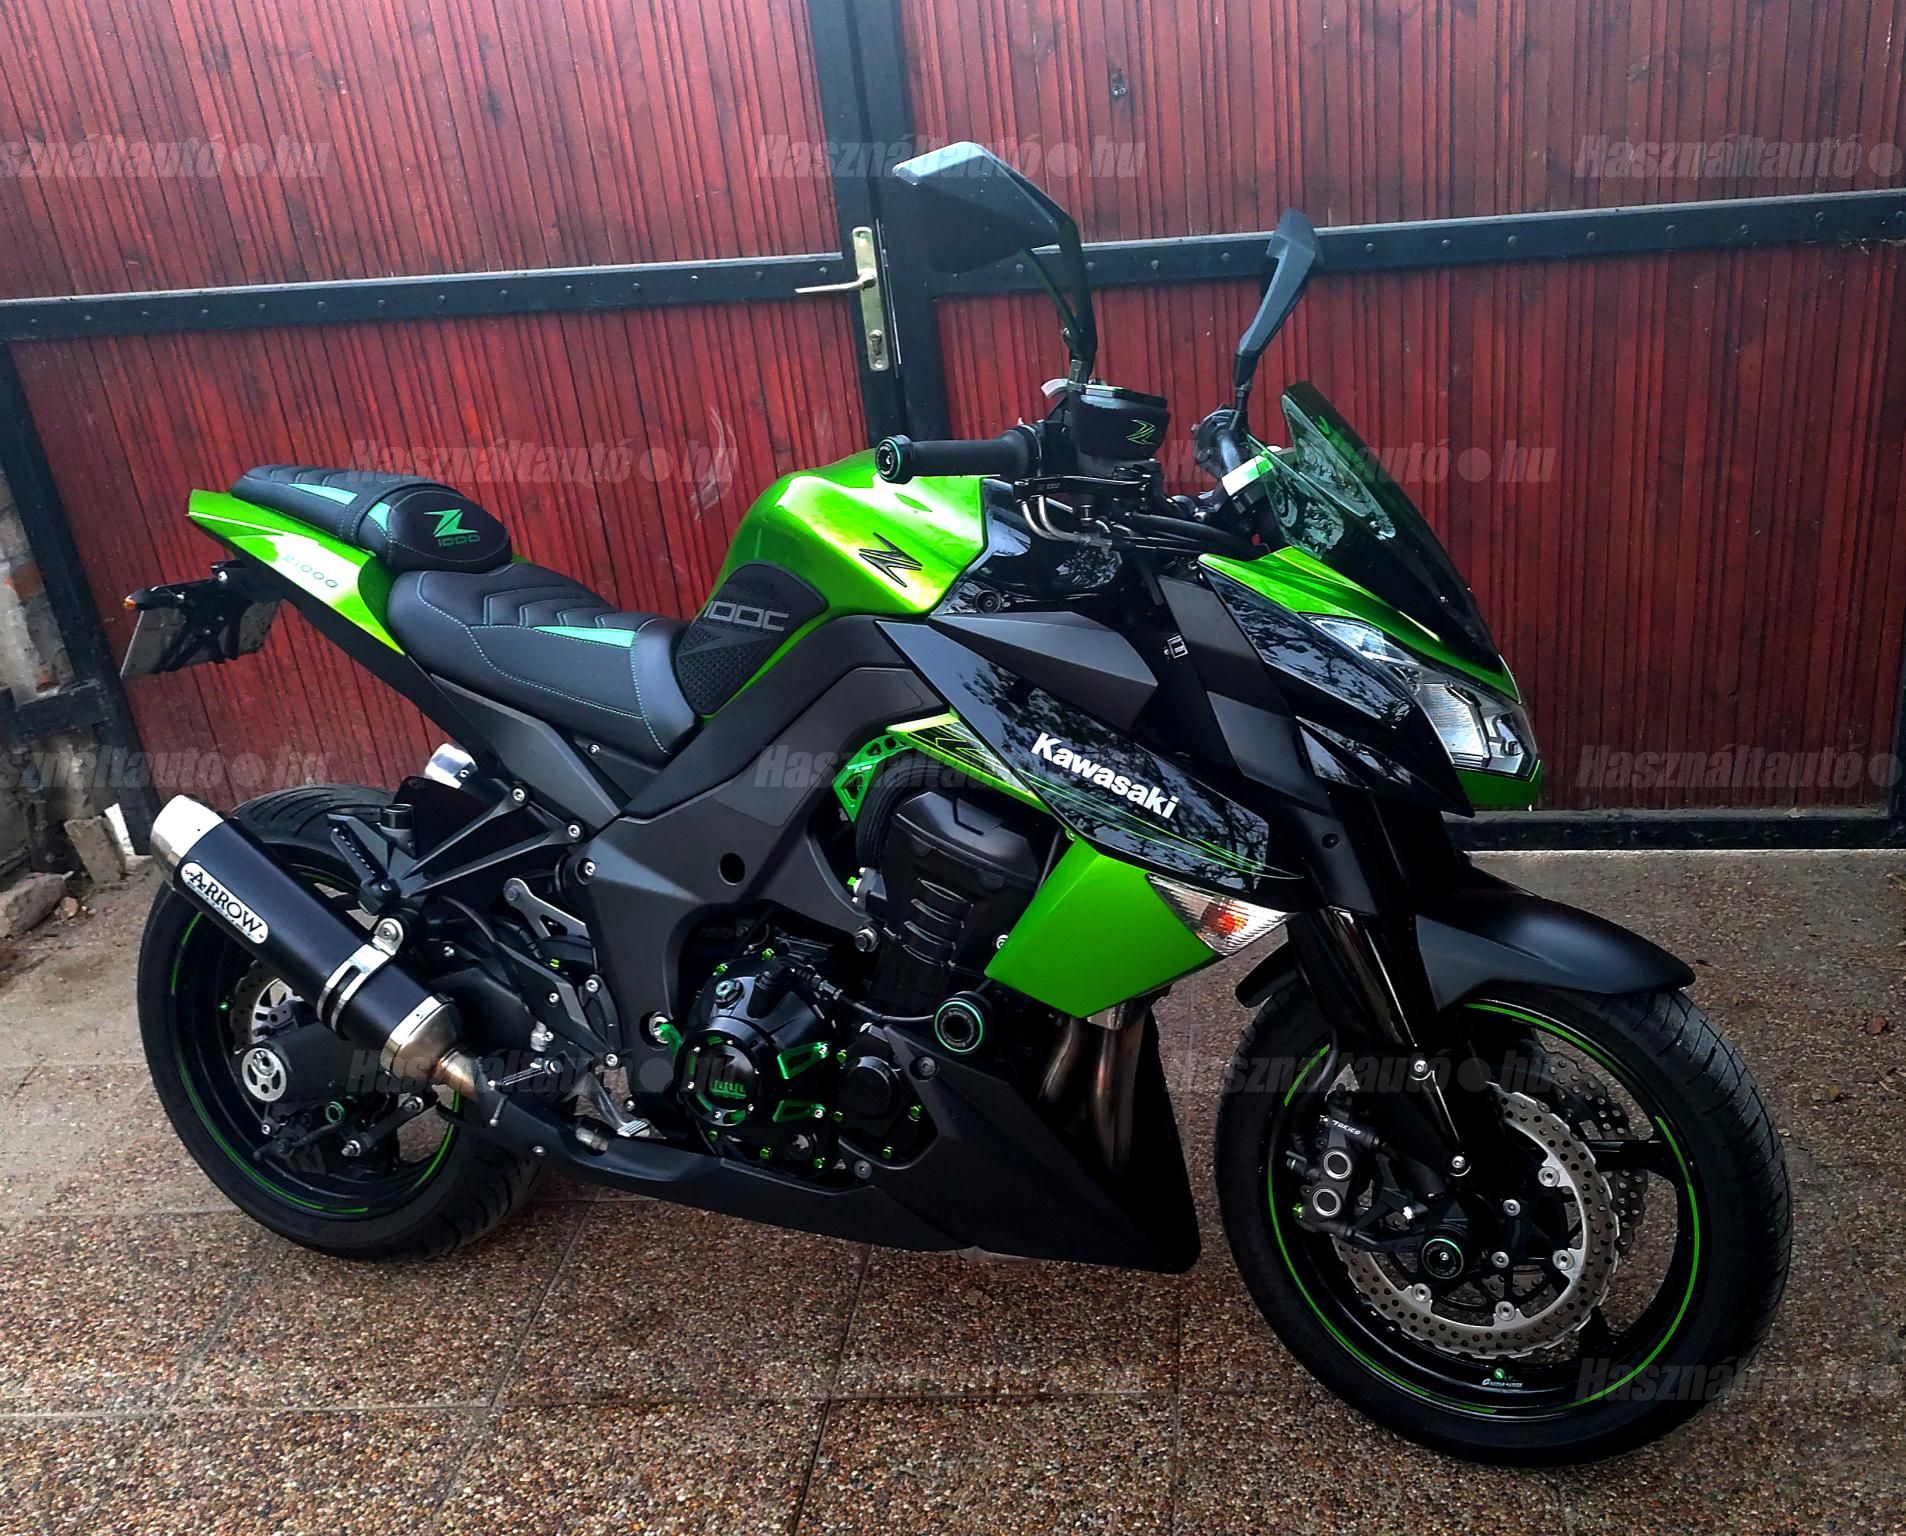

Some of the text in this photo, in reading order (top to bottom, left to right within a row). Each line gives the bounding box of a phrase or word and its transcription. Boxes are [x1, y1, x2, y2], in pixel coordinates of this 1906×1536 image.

[437, 534, 481, 547] 1000
[1030, 732, 1180, 819] Kawasaki
[187, 870, 263, 933] ARROW
